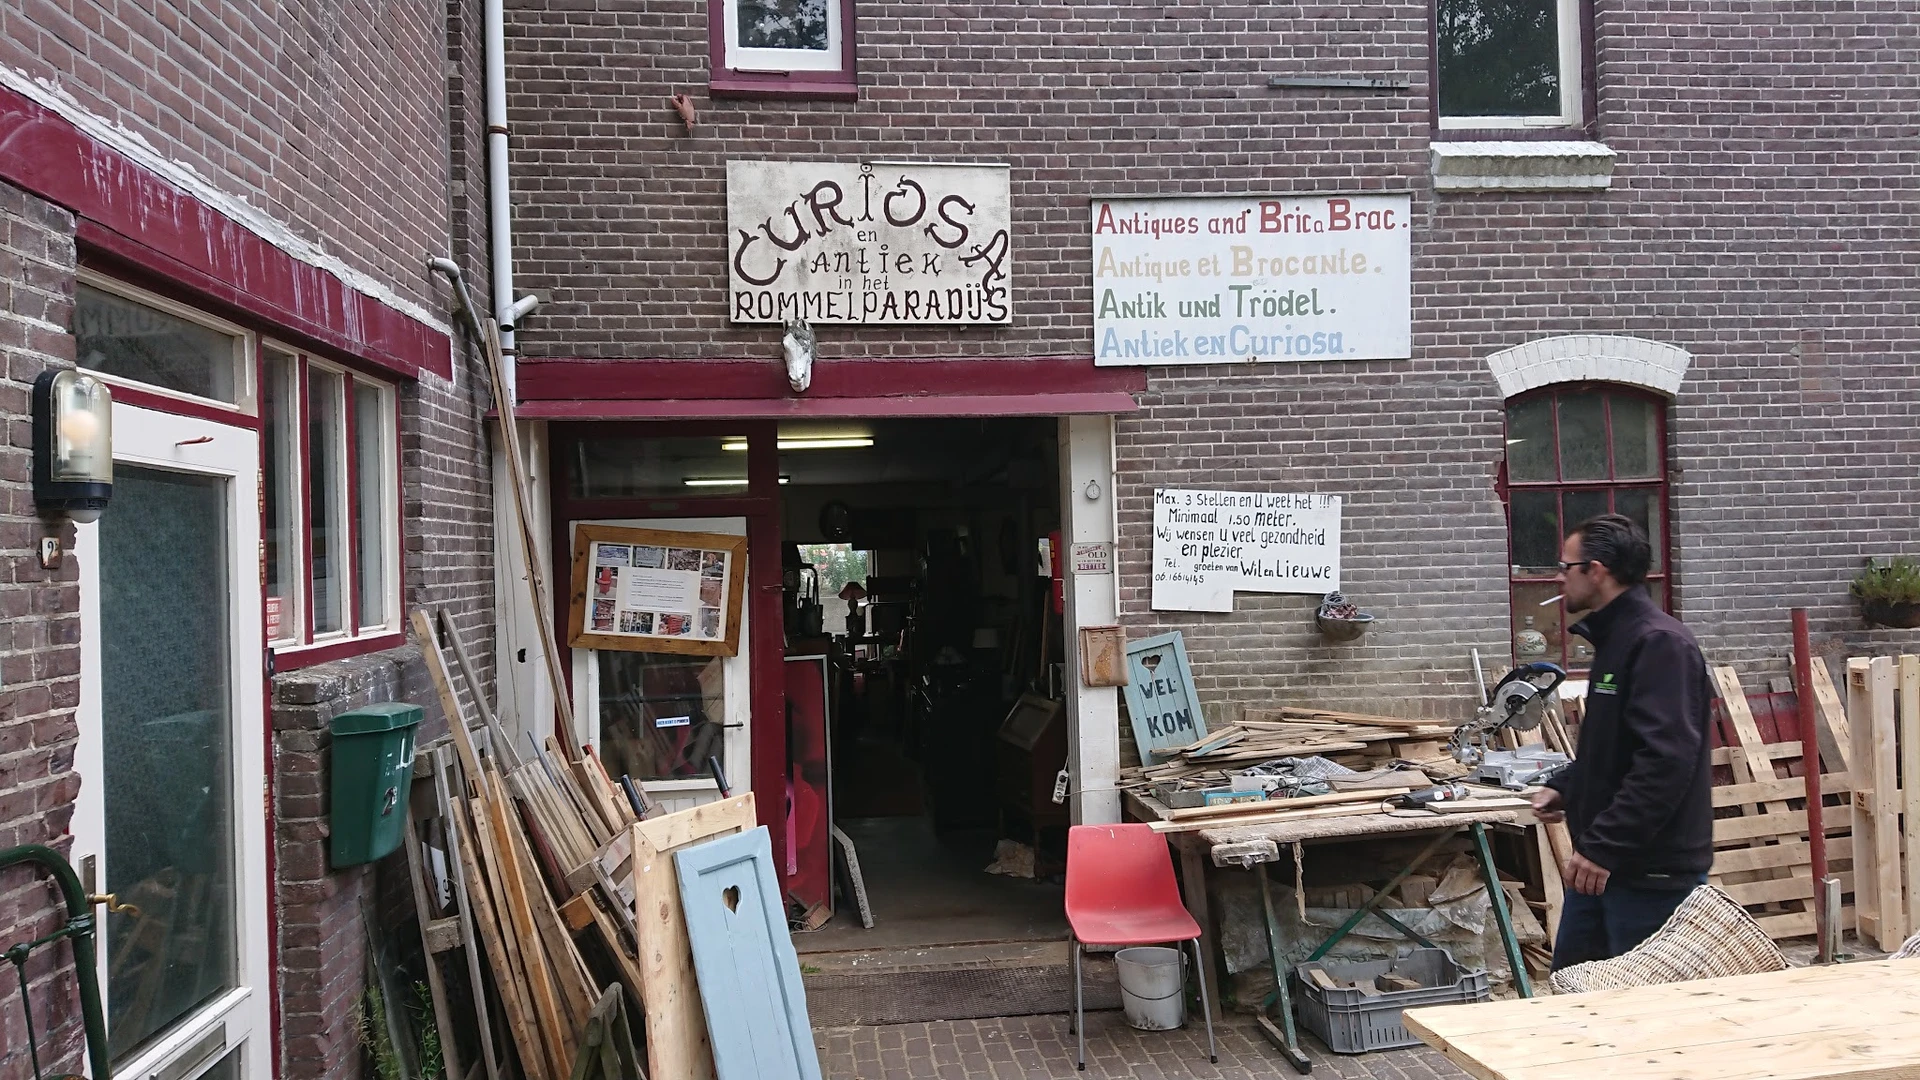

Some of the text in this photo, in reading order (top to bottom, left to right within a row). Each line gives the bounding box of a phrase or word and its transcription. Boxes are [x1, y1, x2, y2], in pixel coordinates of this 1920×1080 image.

[1095, 202, 1199, 240] Antiques
[1208, 209, 1248, 234] and
[1327, 198, 1409, 233] Brac.
[858, 229, 877, 242] en
[1096, 245, 1191, 284] Antique
[1198, 254, 1222, 277] et
[839, 275, 890, 290] in het
[1098, 284, 1337, 319] Antik und Trödel.
[1100, 324, 1356, 358] Antiek en Curiosa.
[1156, 492, 1331, 510] Max. 3 Stellen en U weet het !!!
[1168, 508, 1296, 527] Minimaal 1.50 meter.
[1156, 526, 1326, 549] Wij wensen U veel gezondheid
[1088, 551, 1107, 559] OLD
[1181, 542, 1243, 563] en plezier.
[1163, 558, 1181, 568] Tel.
[1193, 559, 1224, 572] groeten
[1225, 564, 1239, 572] van
[1276, 559, 1331, 579] Lieuwe
[1146, 708, 1193, 738] KOM
